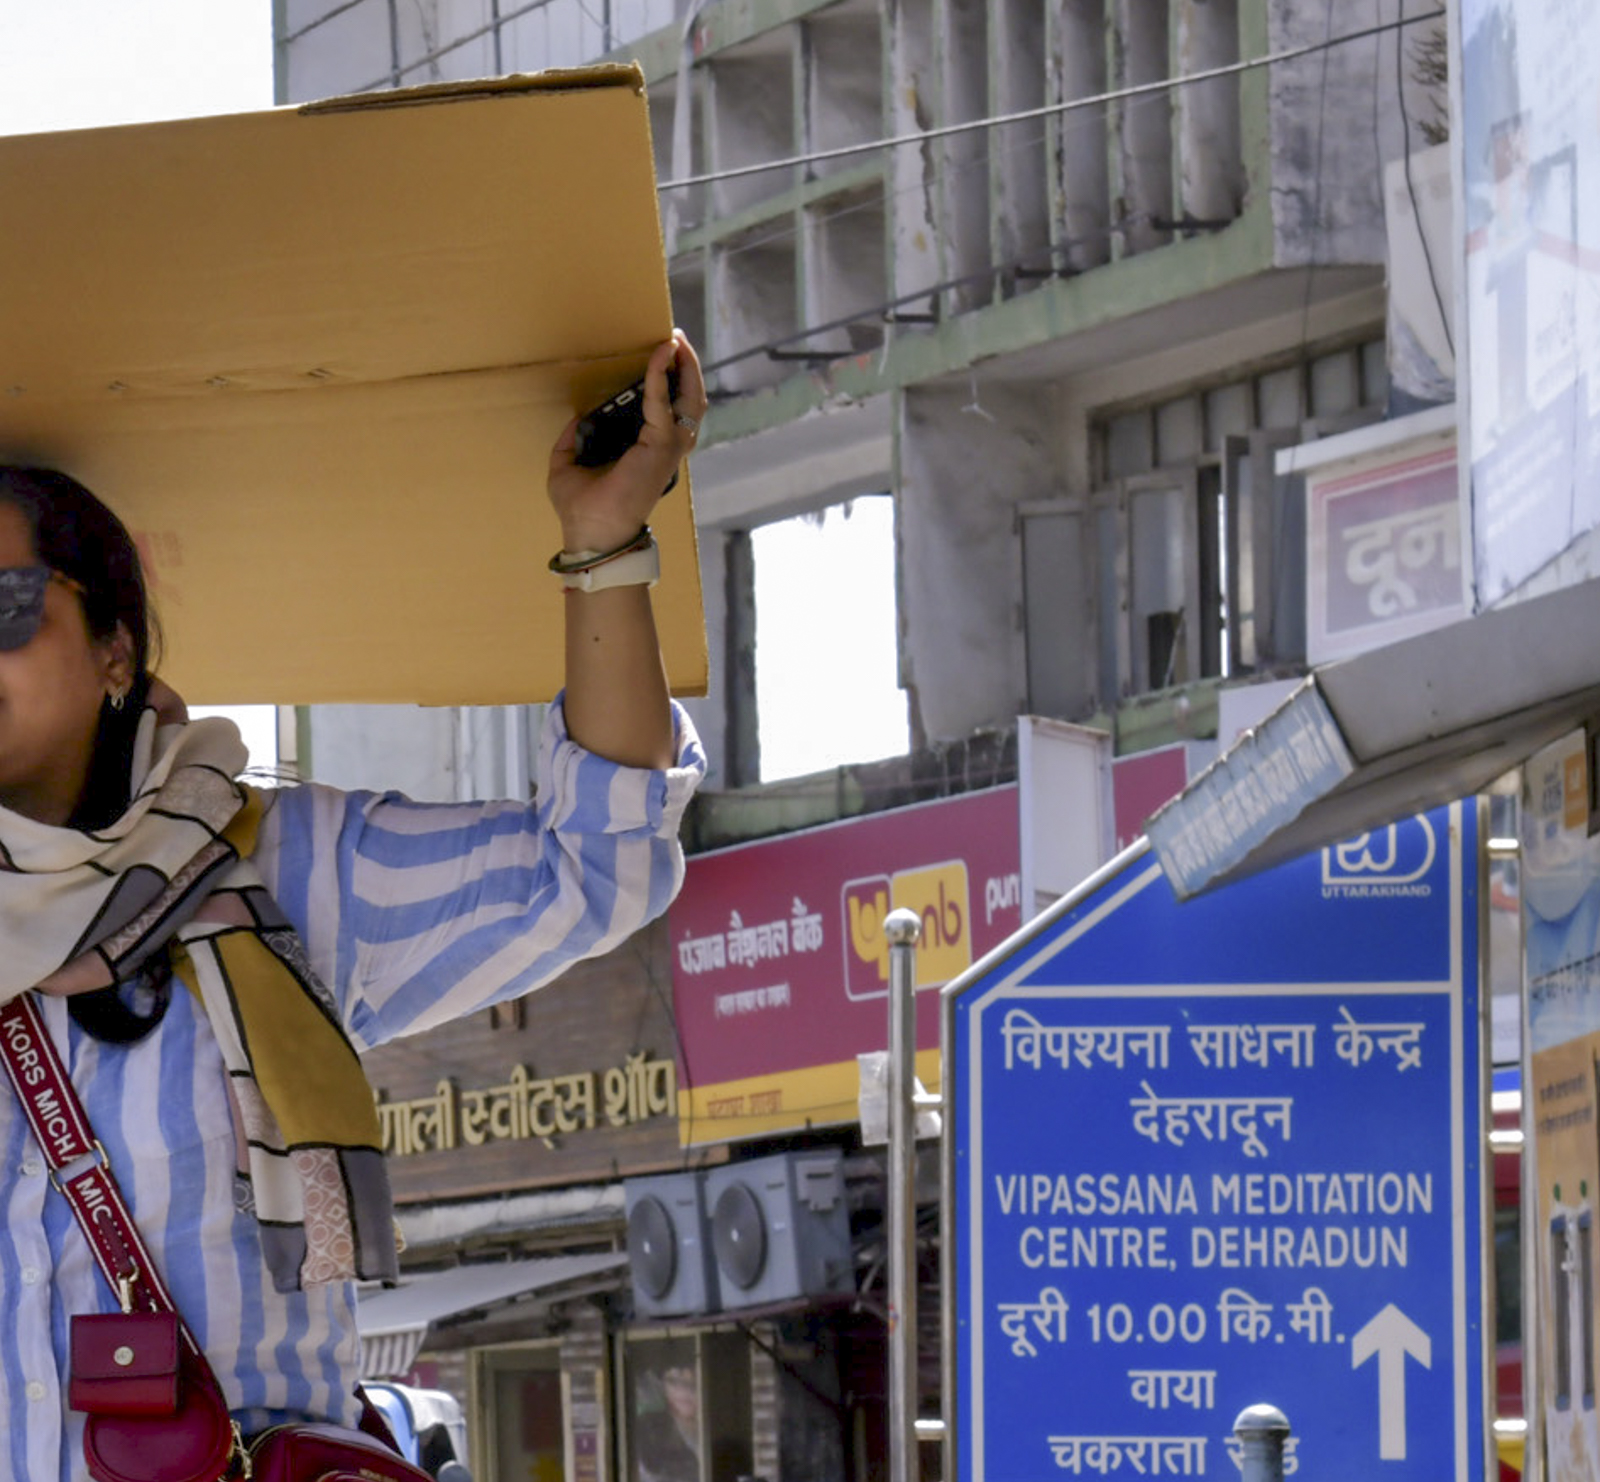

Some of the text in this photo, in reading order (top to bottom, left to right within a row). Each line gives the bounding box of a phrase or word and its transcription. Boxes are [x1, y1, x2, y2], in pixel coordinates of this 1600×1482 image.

[915, 881, 962, 951] nb
[1322, 885, 1431, 899] UTTARAKHAND
[3, 1016, 46, 1086] KORS
[1001, 1005, 1425, 1071] विपश्यना साधना केन्द्र
[462, 1064, 597, 1150] स्वीट्स
[604, 1051, 678, 1127] शॉप
[1130, 1080, 1293, 1157] देहरादून
[996, 1172, 1433, 1215] VIPASSANA MEDITATION
[1019, 1226, 1408, 1271] CENTRE, DEHRADUN
[998, 1287, 1347, 1357] दूरी 10.00 कि.मी.
[1128, 1370, 1217, 1409] वाया
[1048, 1436, 1208, 1476] चकराता
